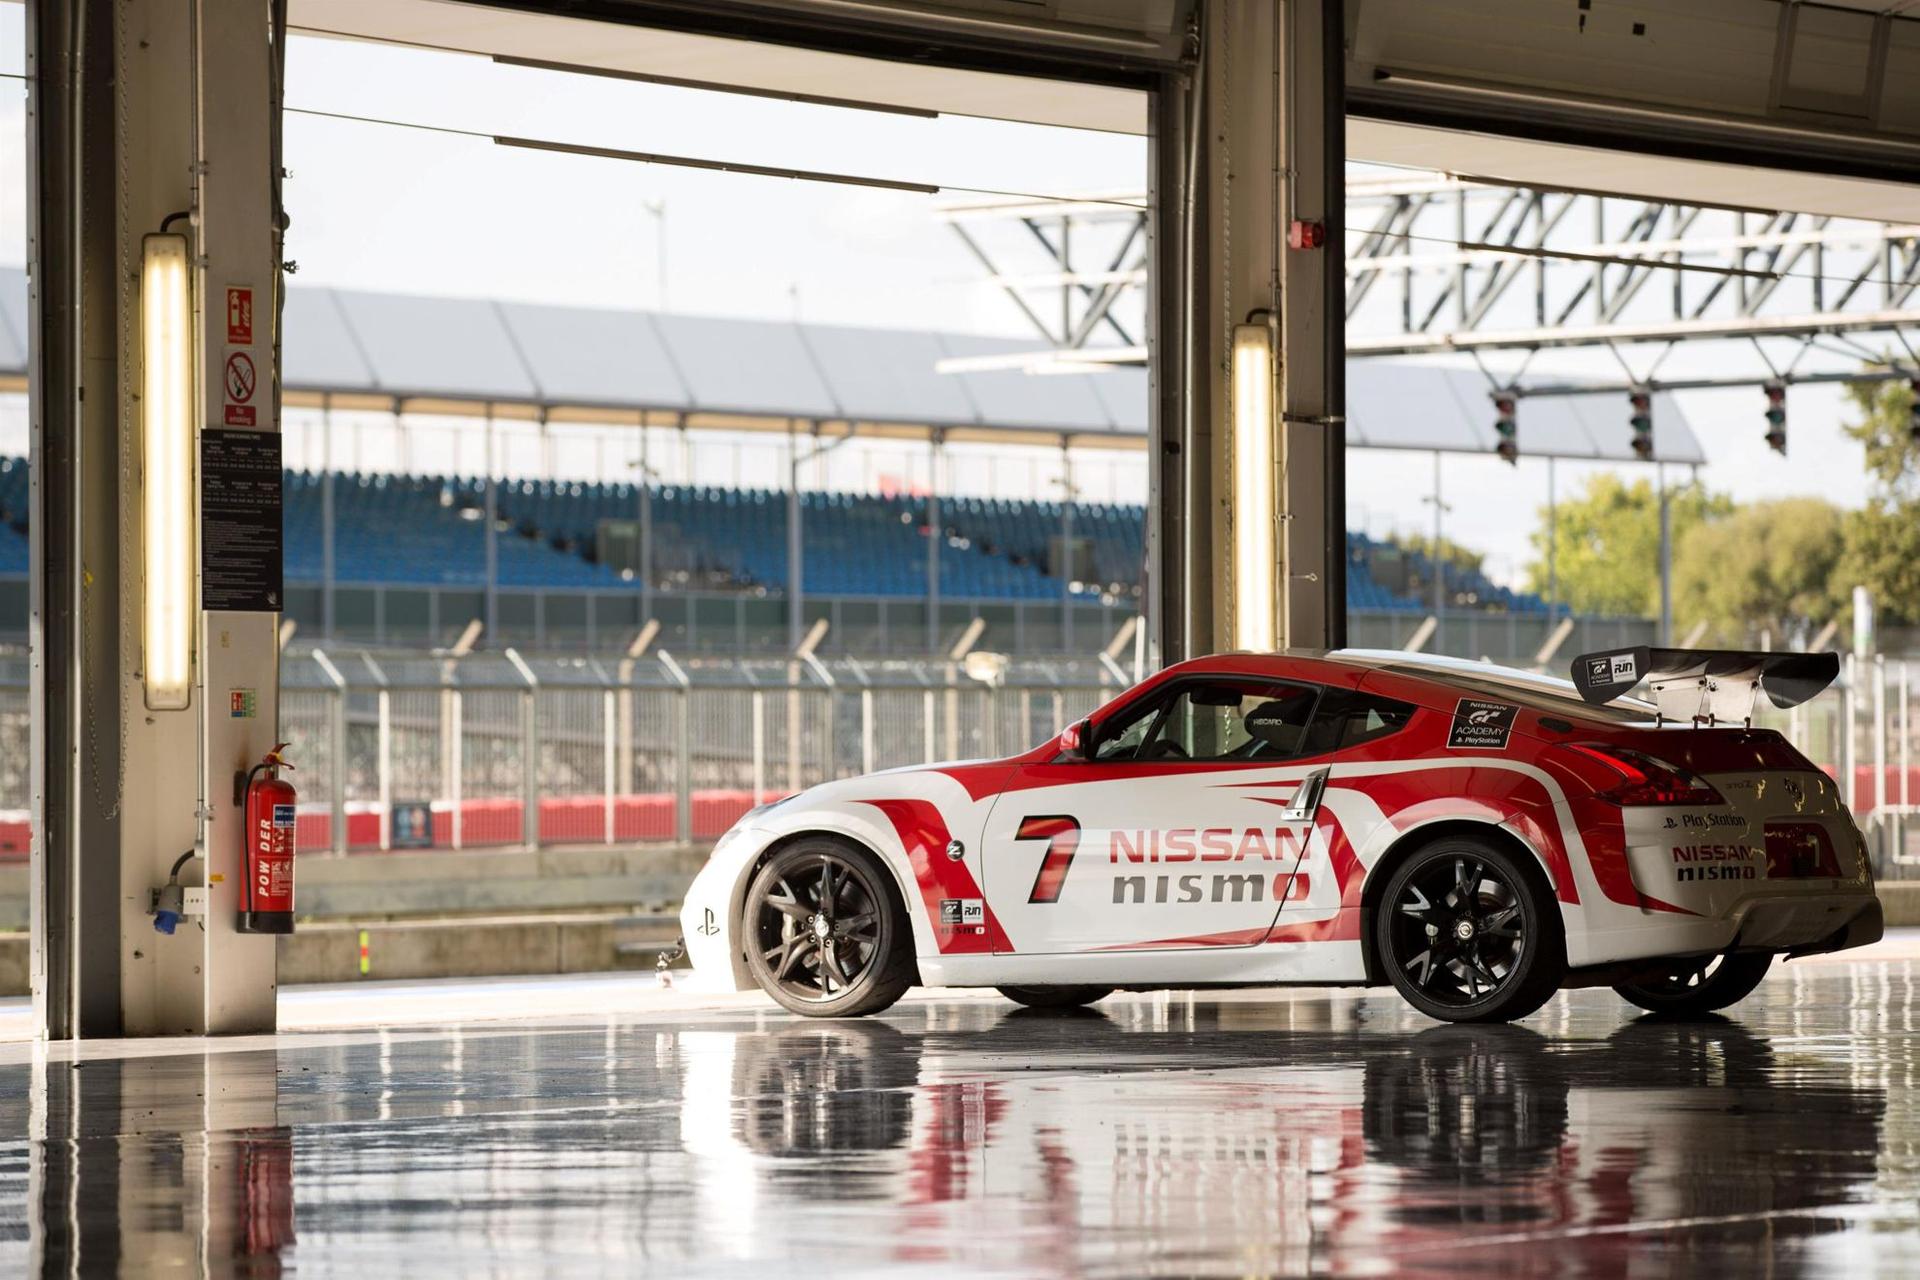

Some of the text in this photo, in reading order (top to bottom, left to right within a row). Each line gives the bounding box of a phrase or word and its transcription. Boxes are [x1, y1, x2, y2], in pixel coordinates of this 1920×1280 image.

[1470, 702, 1507, 711] NISSAN
[1456, 726, 1504, 736] ACADEMY
[1464, 736, 1501, 745] PlayStation
[1682, 813, 1746, 829] PlayStation
[1110, 827, 1311, 864] NISSAN
[1672, 845, 1753, 862] NISSAN
[1014, 814, 1082, 904] 7
[1678, 866, 1756, 881] nismo
[1112, 872, 1311, 904] nismo
